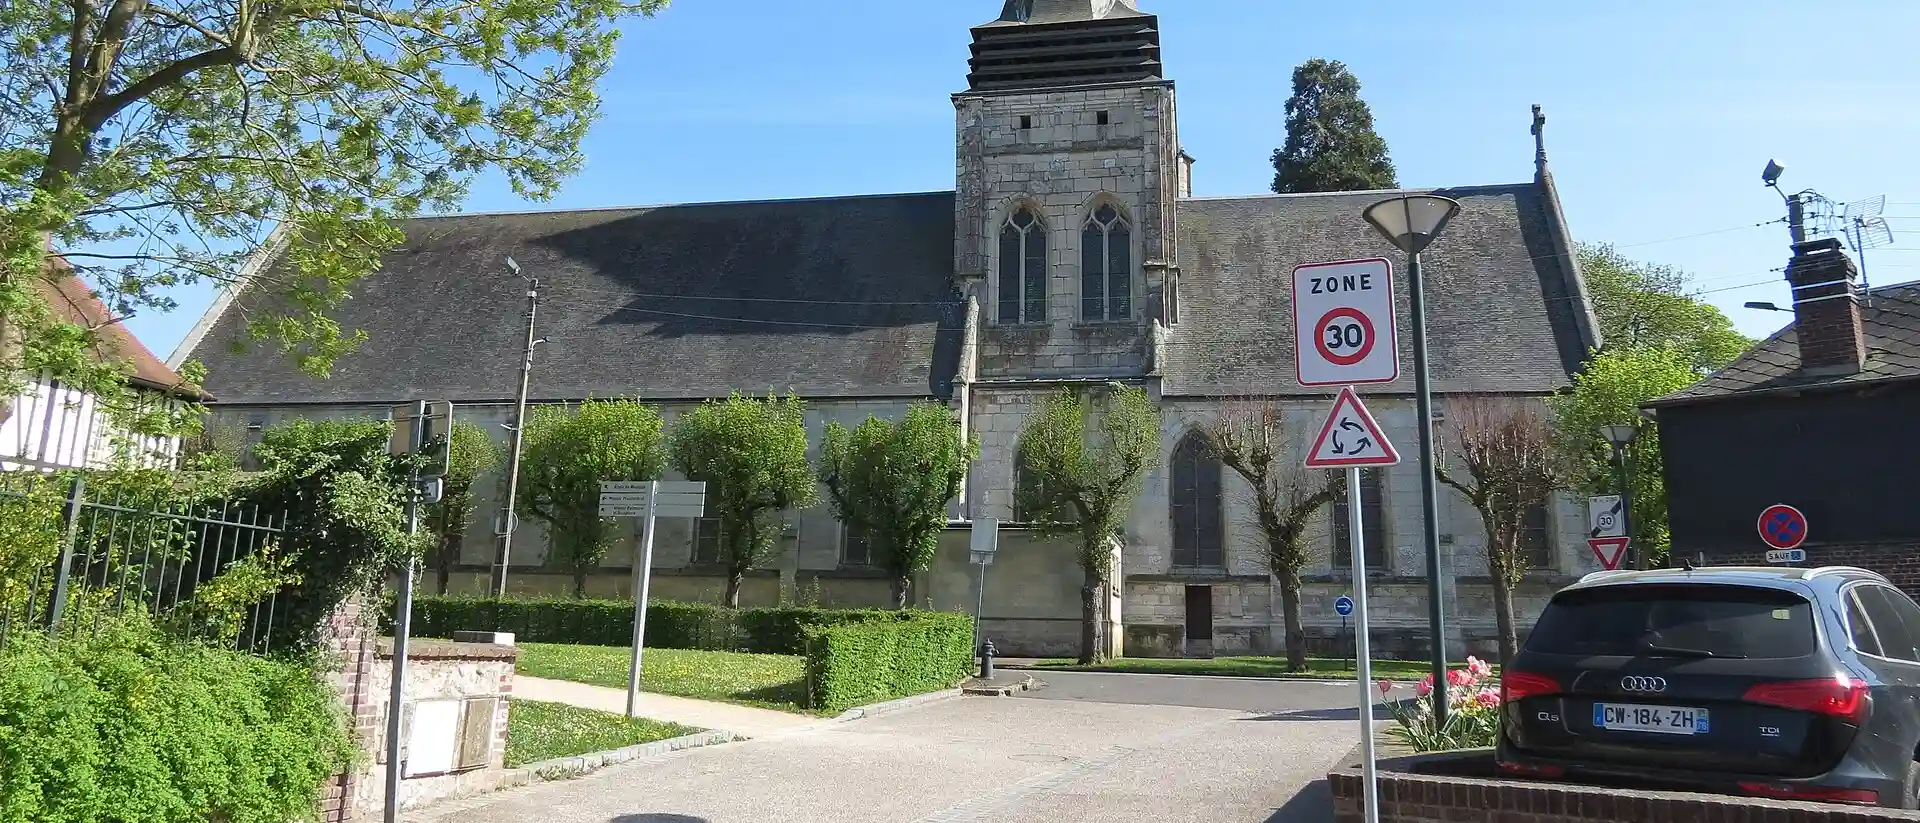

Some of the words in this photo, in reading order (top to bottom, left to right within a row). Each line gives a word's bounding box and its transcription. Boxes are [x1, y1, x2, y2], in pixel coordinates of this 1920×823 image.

[1310, 274, 1371, 294] ZONE
[1326, 324, 1363, 348] 30
[1600, 517, 1612, 525] 30
[1768, 551, 1790, 560] SAUF
[1538, 711, 1560, 722] Q5
